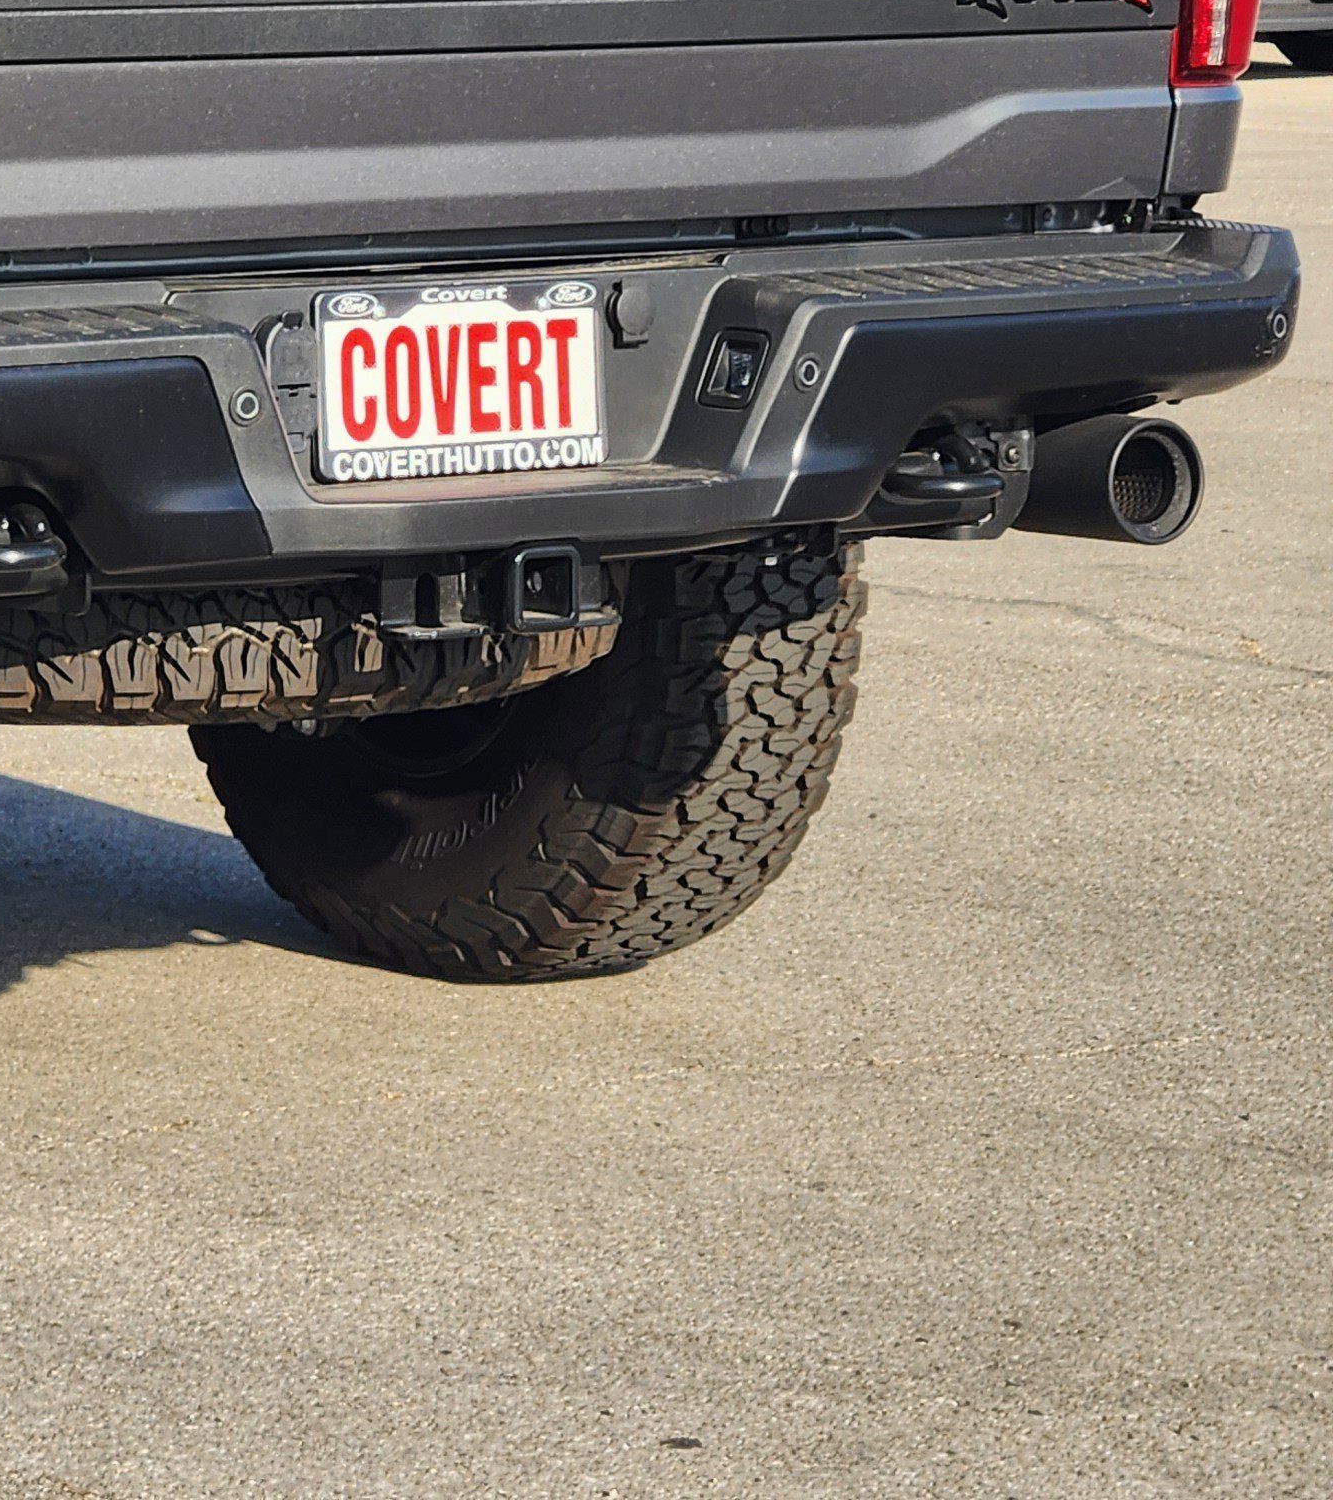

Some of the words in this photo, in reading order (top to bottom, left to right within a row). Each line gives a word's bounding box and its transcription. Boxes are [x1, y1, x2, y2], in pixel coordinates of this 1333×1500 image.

[420, 285, 508, 304] Covert
[339, 317, 579, 442] COVERT
[332, 437, 605, 483] COVERTHUTTO.COM
